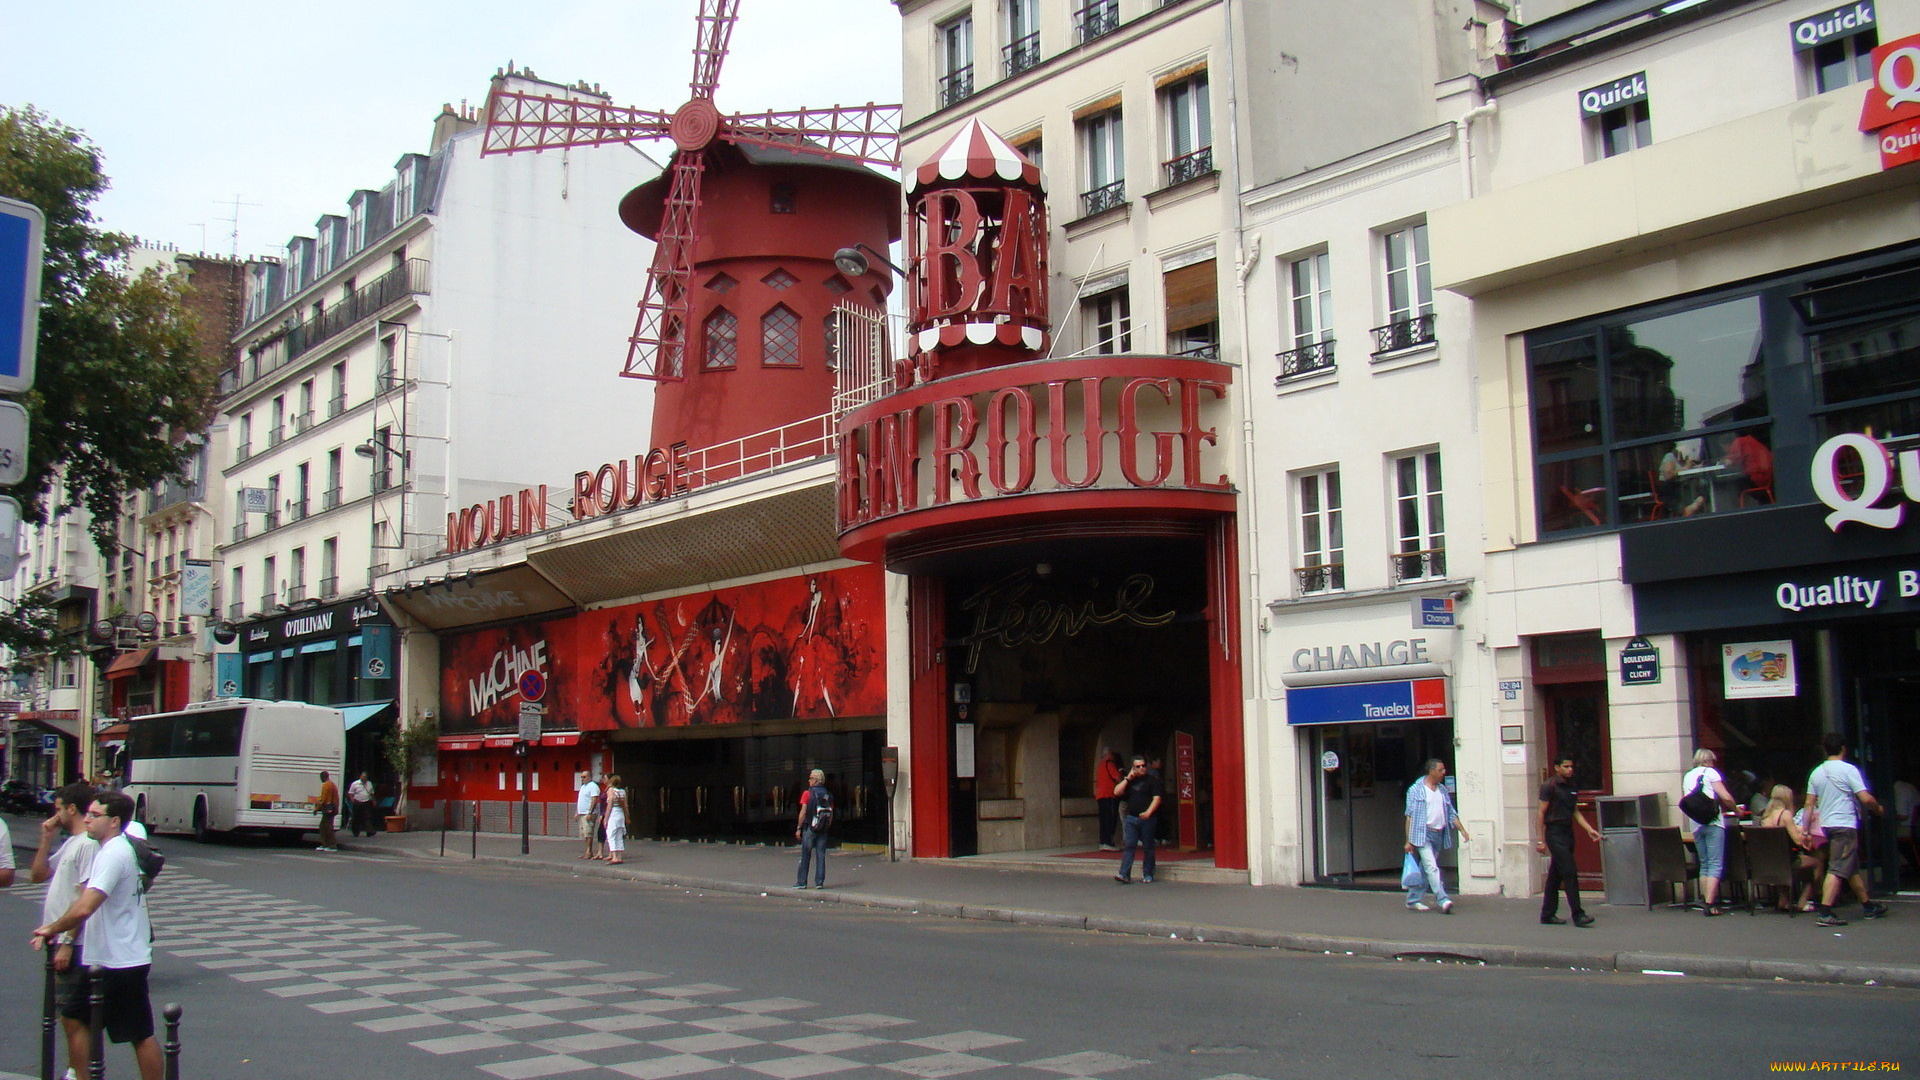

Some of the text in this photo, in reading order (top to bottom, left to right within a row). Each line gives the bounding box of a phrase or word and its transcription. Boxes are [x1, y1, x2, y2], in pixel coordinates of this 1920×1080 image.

[1795, 5, 1873, 45] Quick
[1582, 76, 1646, 113] Quick
[1881, 127, 1920, 154] Qui
[931, 377, 1230, 504] ROUGE
[446, 440, 691, 554] MOULIN ROUGE
[1776, 575, 1881, 612] Quality
[285, 612, 334, 638] O'SULLIVANS
[1426, 613, 1450, 625] Change
[1292, 637, 1428, 673] CHANGE
[1623, 655, 1656, 664] BOULEVARD
[469, 640, 548, 717] MACHINE
[1362, 702, 1411, 718] Travelex
[47, 738, 55, 747] P
